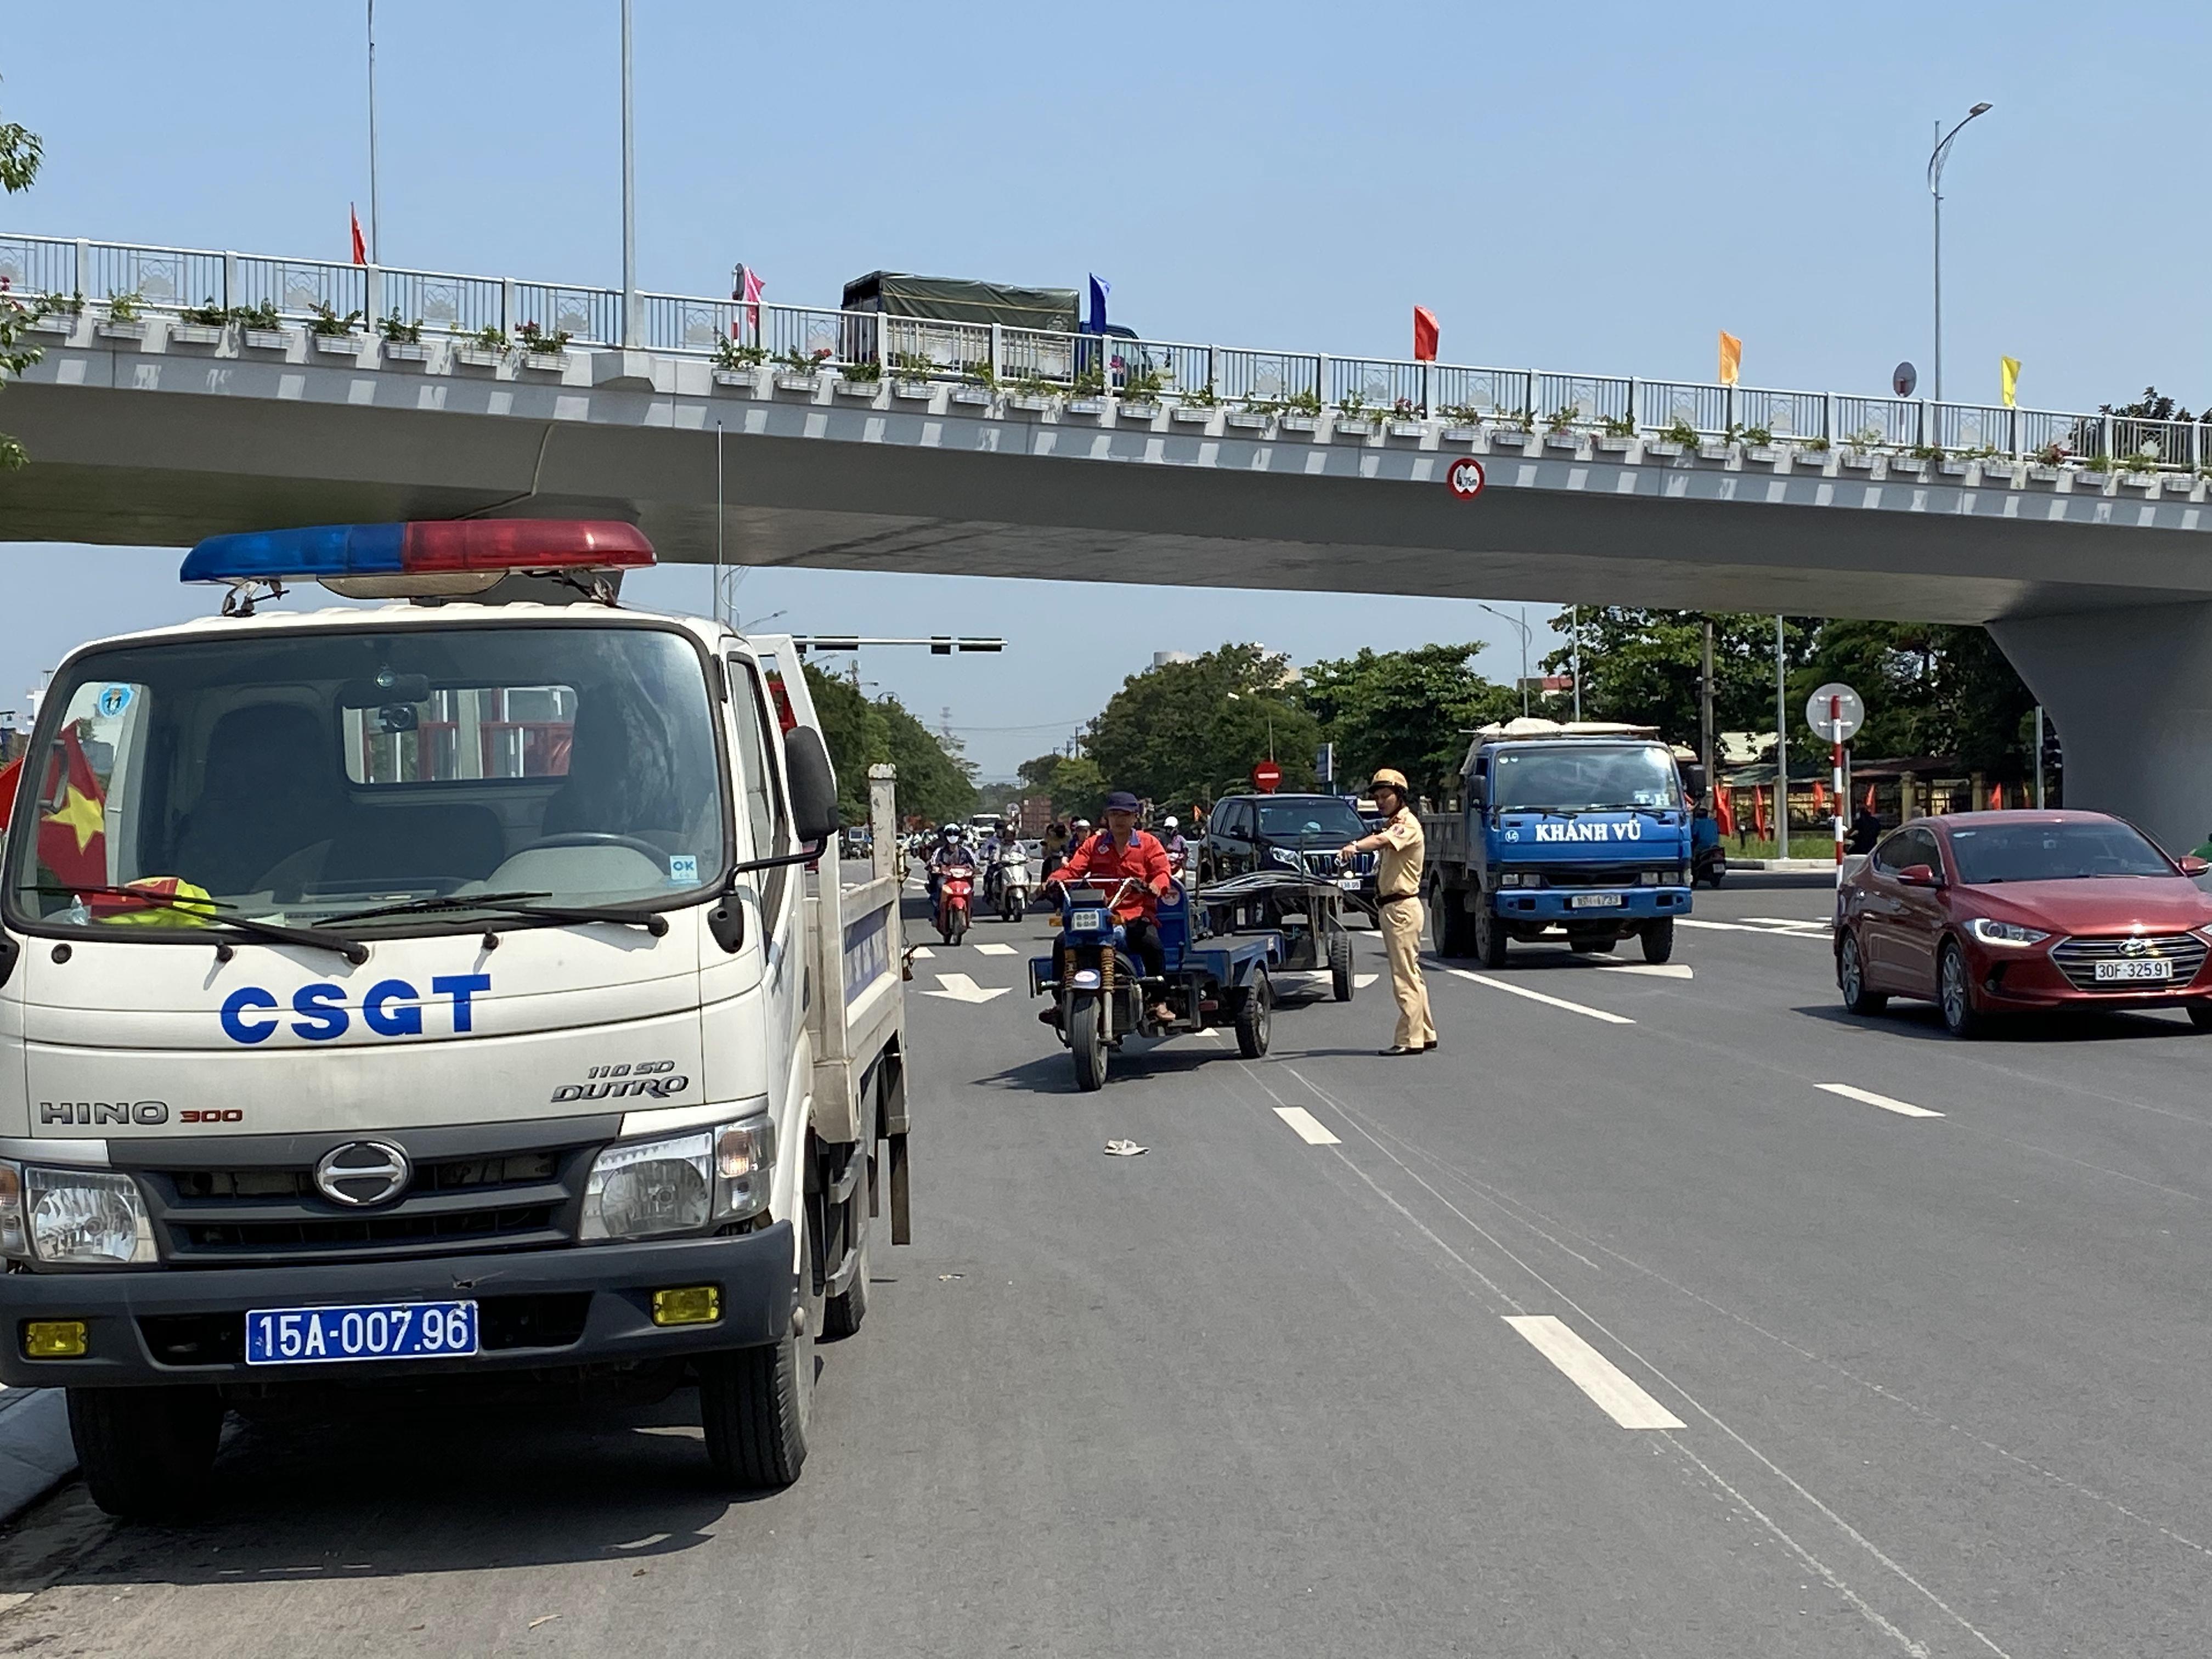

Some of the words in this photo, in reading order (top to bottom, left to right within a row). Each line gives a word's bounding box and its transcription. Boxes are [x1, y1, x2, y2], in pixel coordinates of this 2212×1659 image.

[1535, 820, 1609, 842] KHÁNH
[673, 861, 694, 871] OK
[2098, 962, 2169, 978] 30F-325.91
[221, 973, 491, 1043] CSGT
[588, 1064, 631, 1079] 110
[633, 1060, 675, 1076] SD
[550, 1075, 689, 1103] DUTRO
[40, 1101, 169, 1125] HINO
[179, 1109, 243, 1123] 300
[259, 1309, 469, 1360] 15A-007.96
